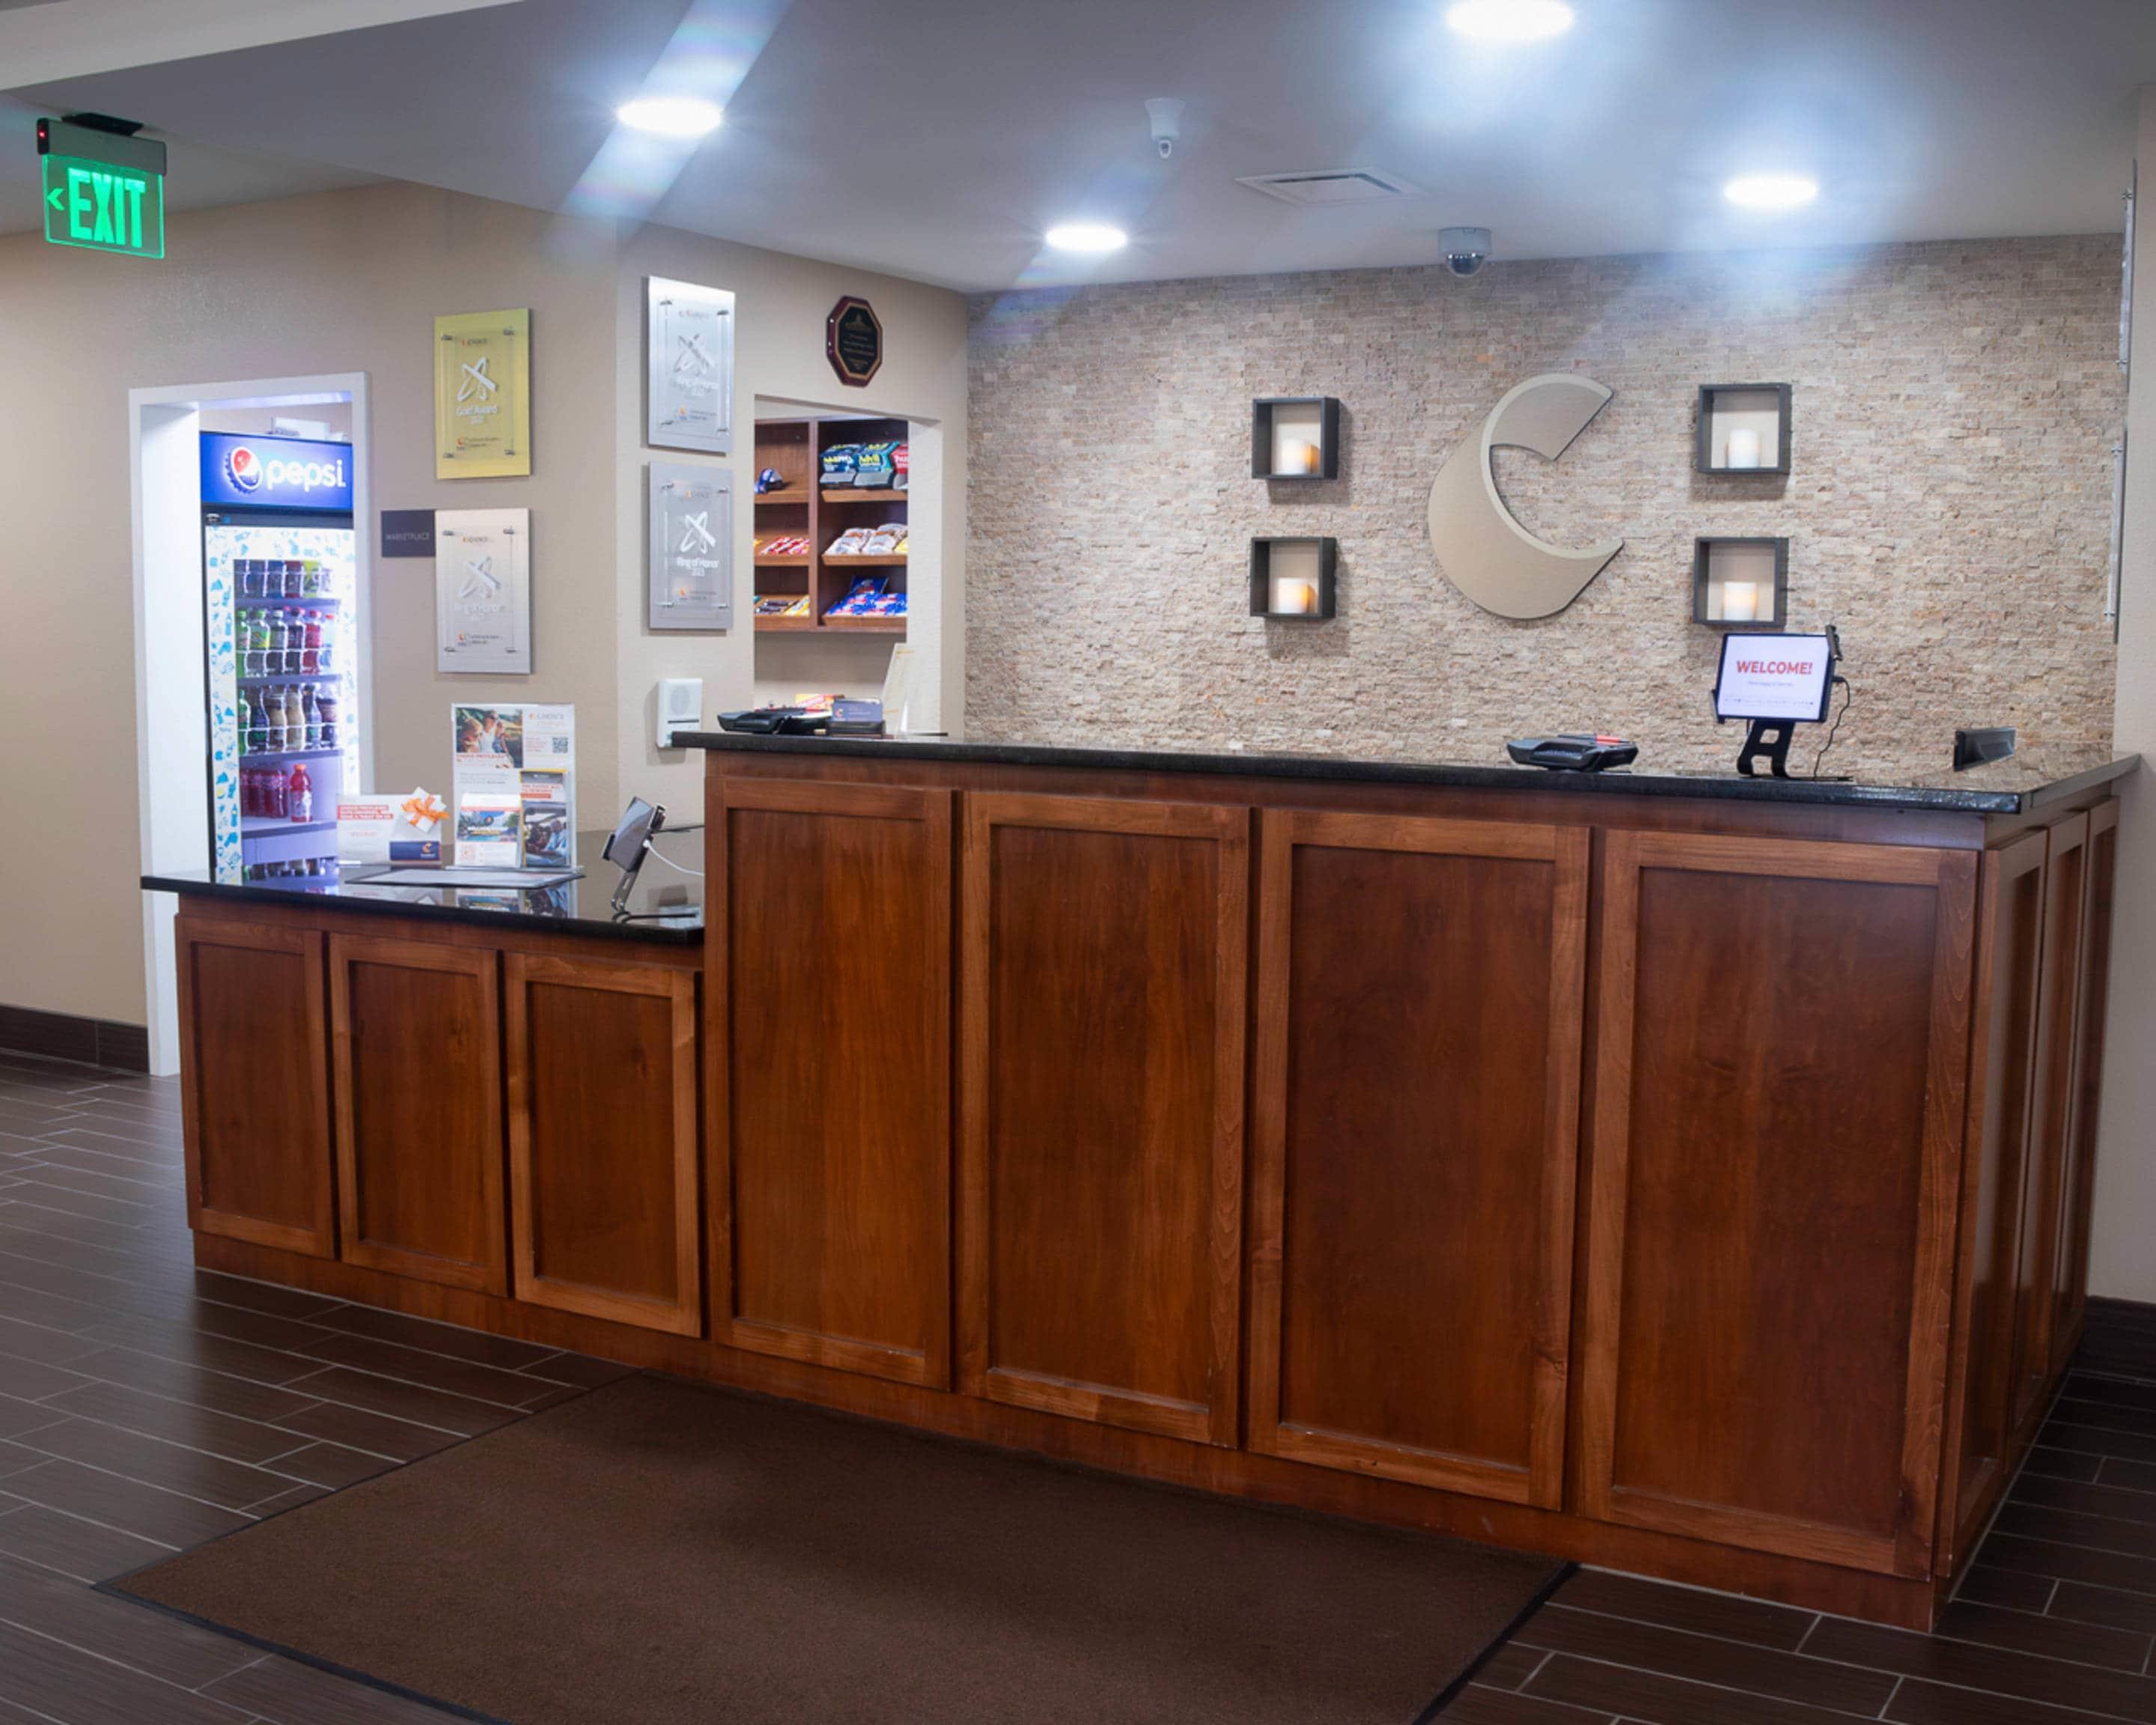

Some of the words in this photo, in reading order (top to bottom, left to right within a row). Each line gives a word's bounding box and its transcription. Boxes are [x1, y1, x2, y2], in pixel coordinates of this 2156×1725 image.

[68, 167, 146, 249] EXIT
[266, 458, 344, 493] pepsi
[1736, 660, 1813, 675] WELCOME!
